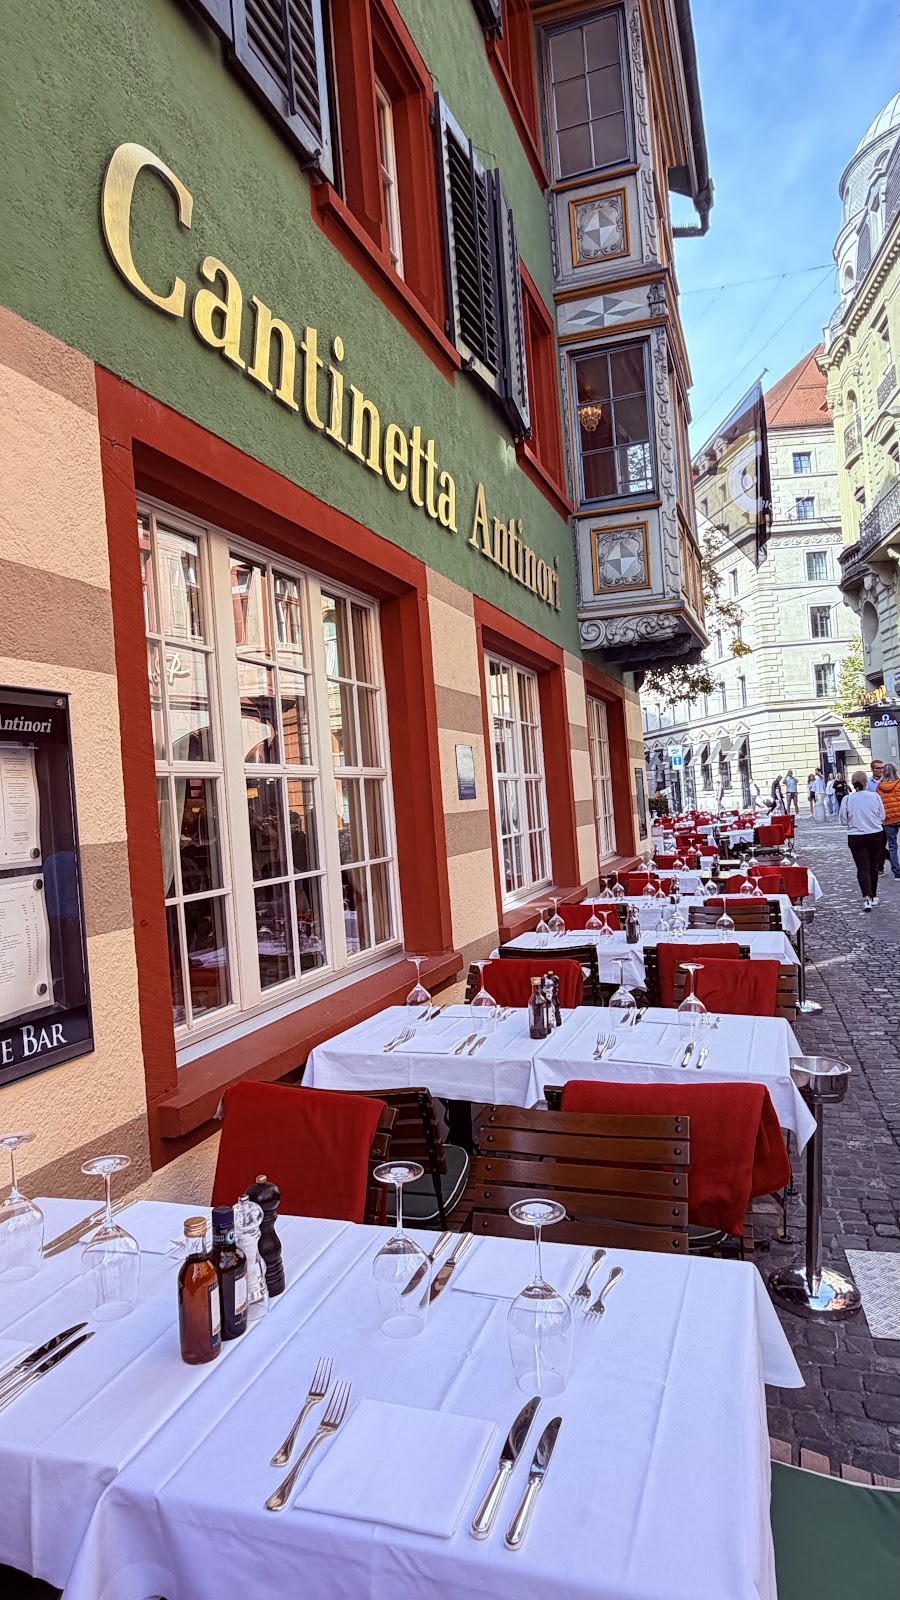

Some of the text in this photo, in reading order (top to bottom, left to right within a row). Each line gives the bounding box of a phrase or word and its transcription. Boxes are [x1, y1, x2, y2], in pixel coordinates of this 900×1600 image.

[101, 142, 562, 611] Cantinetta Antinori
[20, 1023, 68, 1057] BAR
